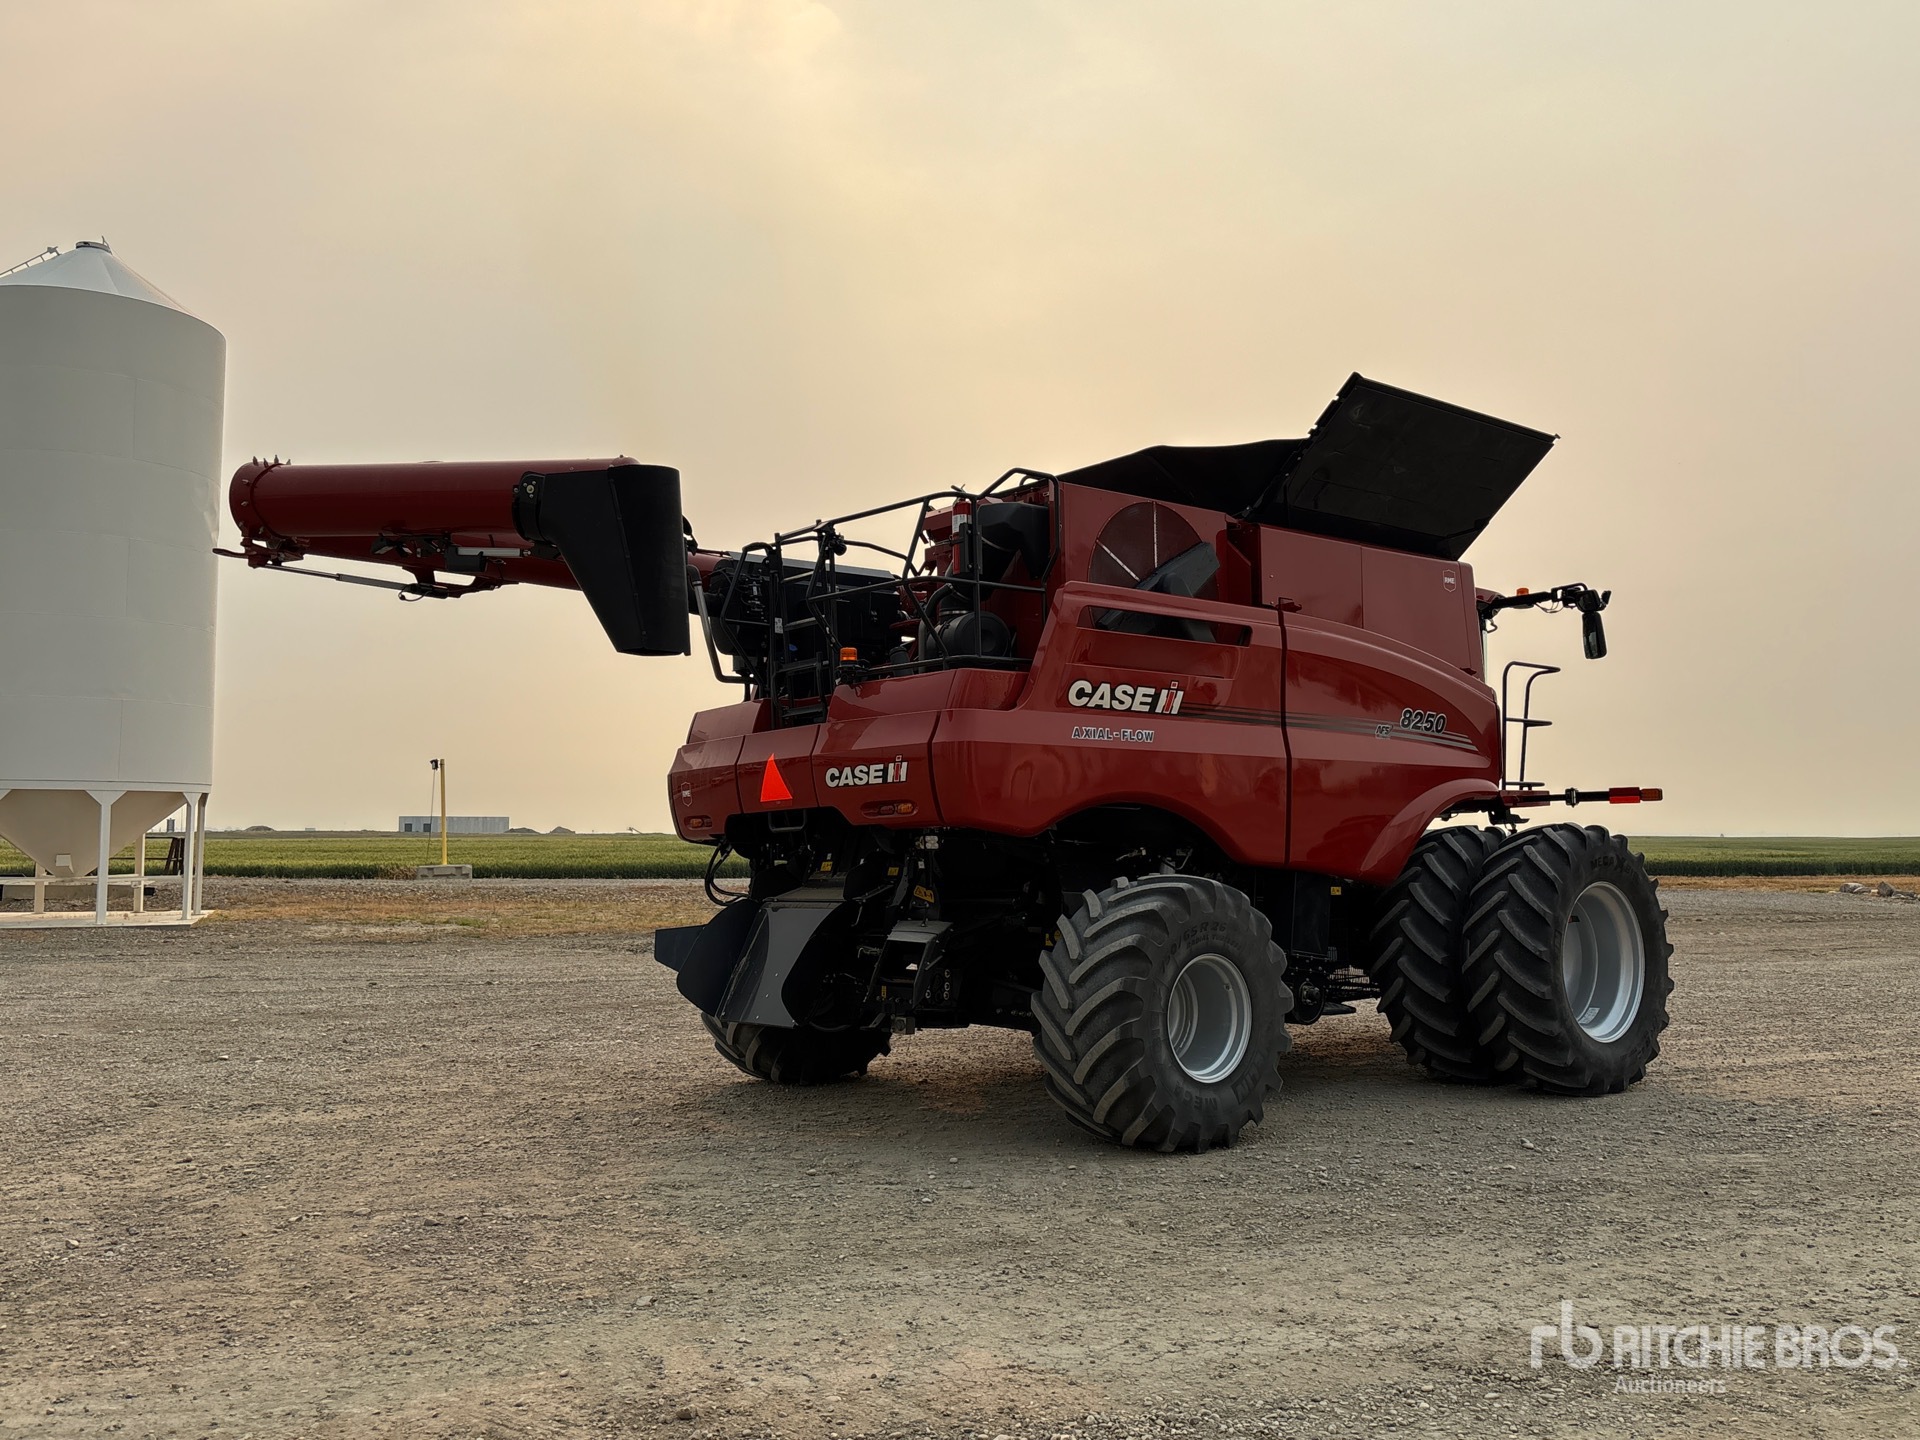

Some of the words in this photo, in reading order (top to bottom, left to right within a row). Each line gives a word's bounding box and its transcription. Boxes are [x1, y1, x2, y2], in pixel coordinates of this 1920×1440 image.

[1068, 680, 1156, 712] CASE
[1400, 707, 1447, 734] 8250
[1072, 726, 1154, 743] AXIAL-FLOW
[825, 765, 884, 788] CASE
